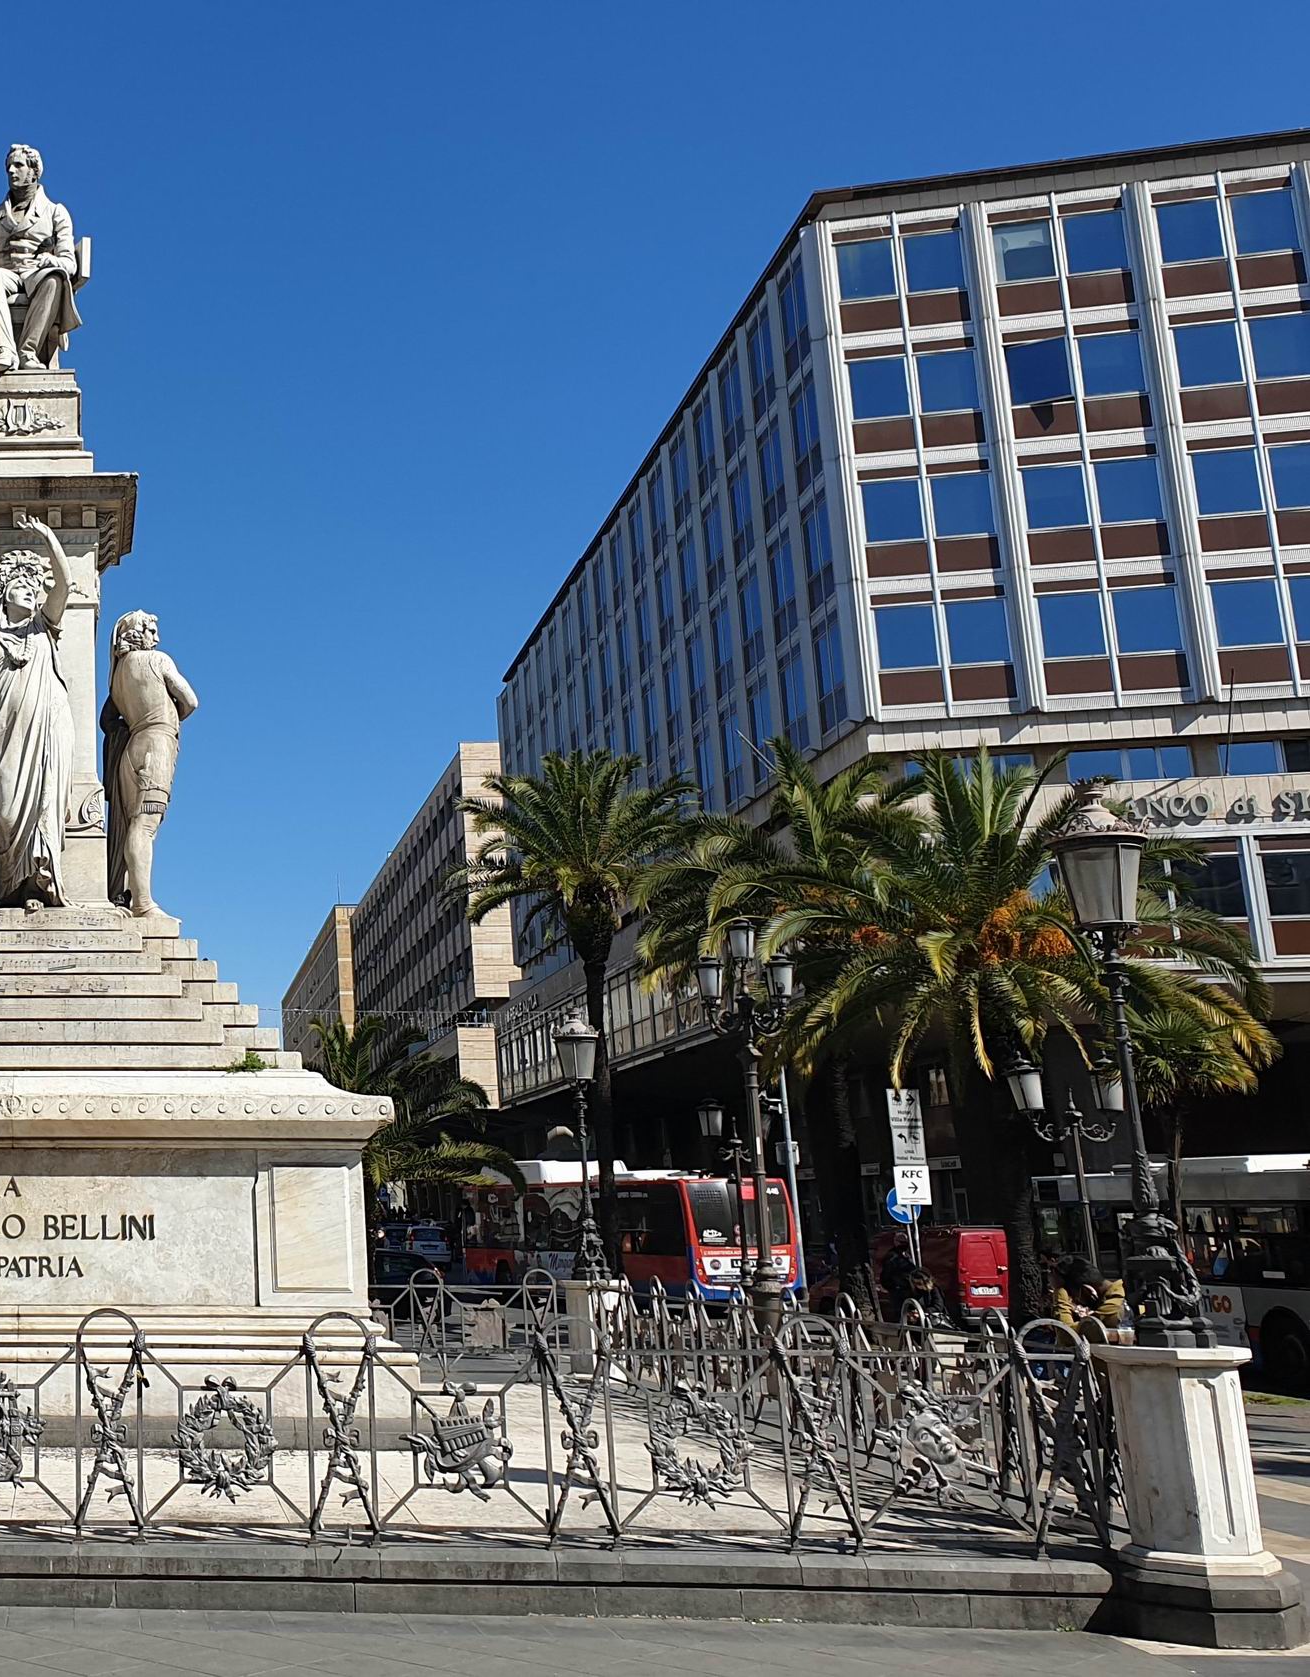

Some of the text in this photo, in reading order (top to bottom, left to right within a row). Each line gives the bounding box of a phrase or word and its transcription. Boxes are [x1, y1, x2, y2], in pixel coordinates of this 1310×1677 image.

[1124, 792, 1214, 820] ANCO
[1233, 793, 1260, 815] di
[901, 1170, 923, 1178] KFC
[3, 1176, 22, 1198] A
[43, 1214, 156, 1241] BELLINI
